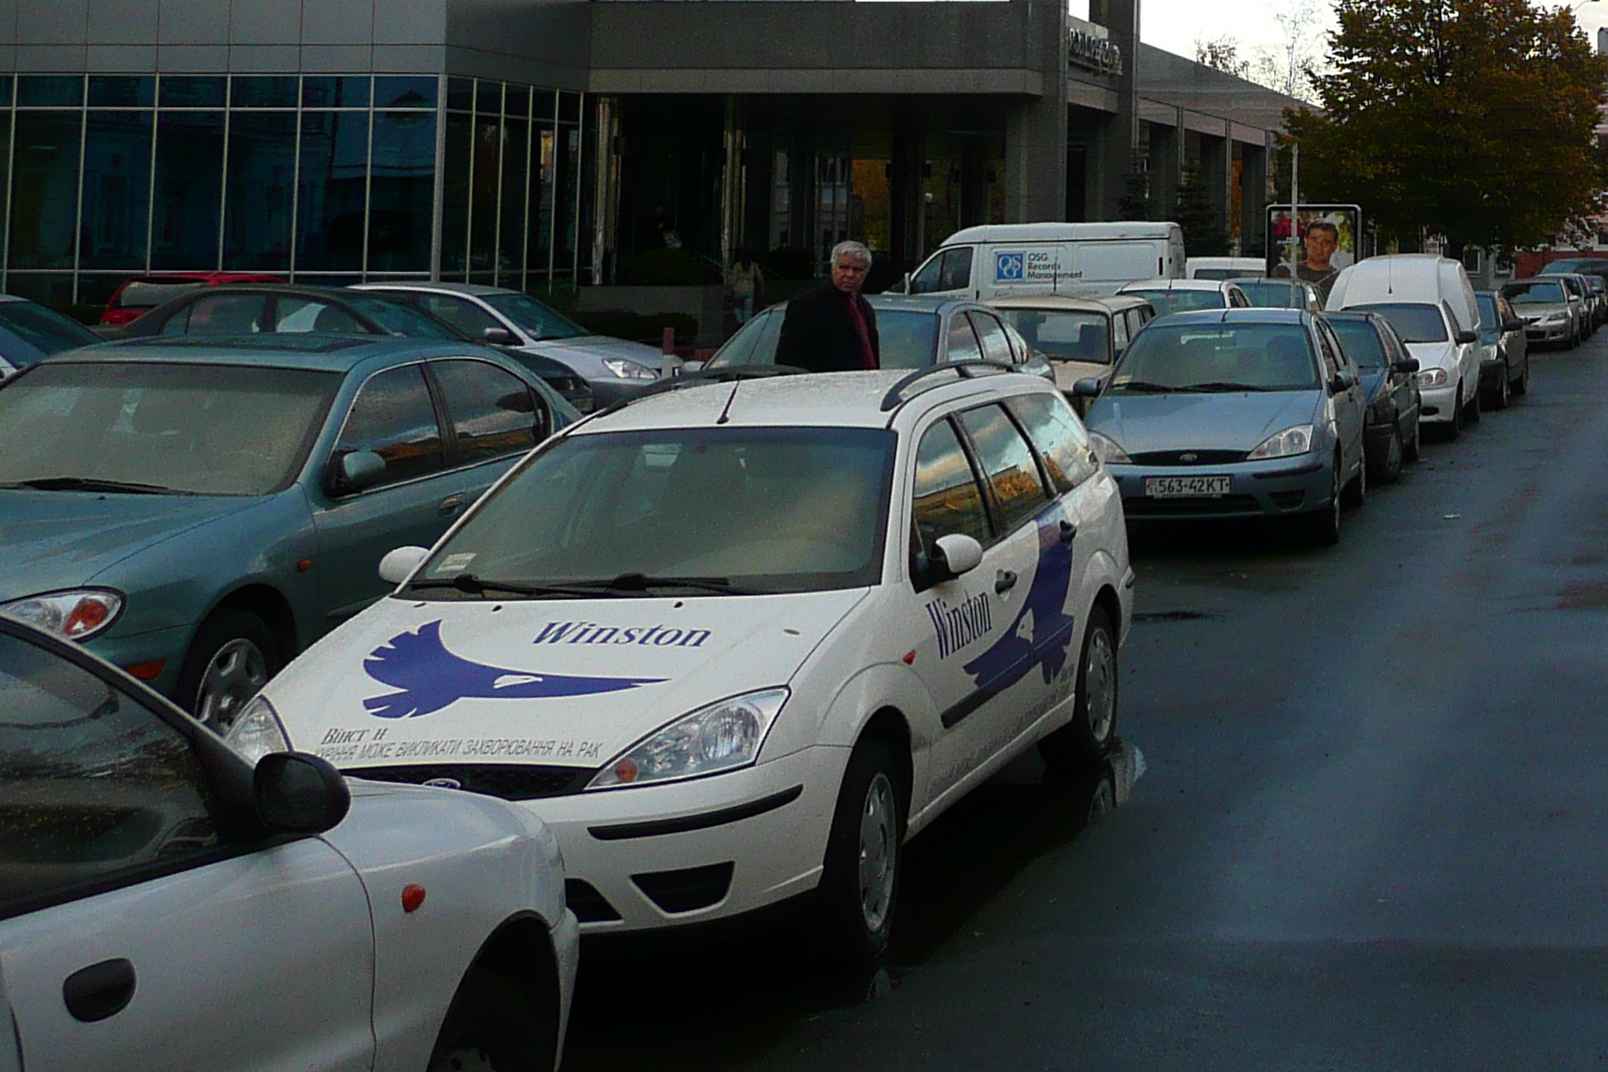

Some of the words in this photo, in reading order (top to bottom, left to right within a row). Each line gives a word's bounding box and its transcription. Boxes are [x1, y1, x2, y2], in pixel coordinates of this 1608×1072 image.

[532, 621, 712, 647] Winston
[924, 590, 993, 661] Winston
[557, 740, 574, 757] НА
[576, 741, 603, 759] РАК
